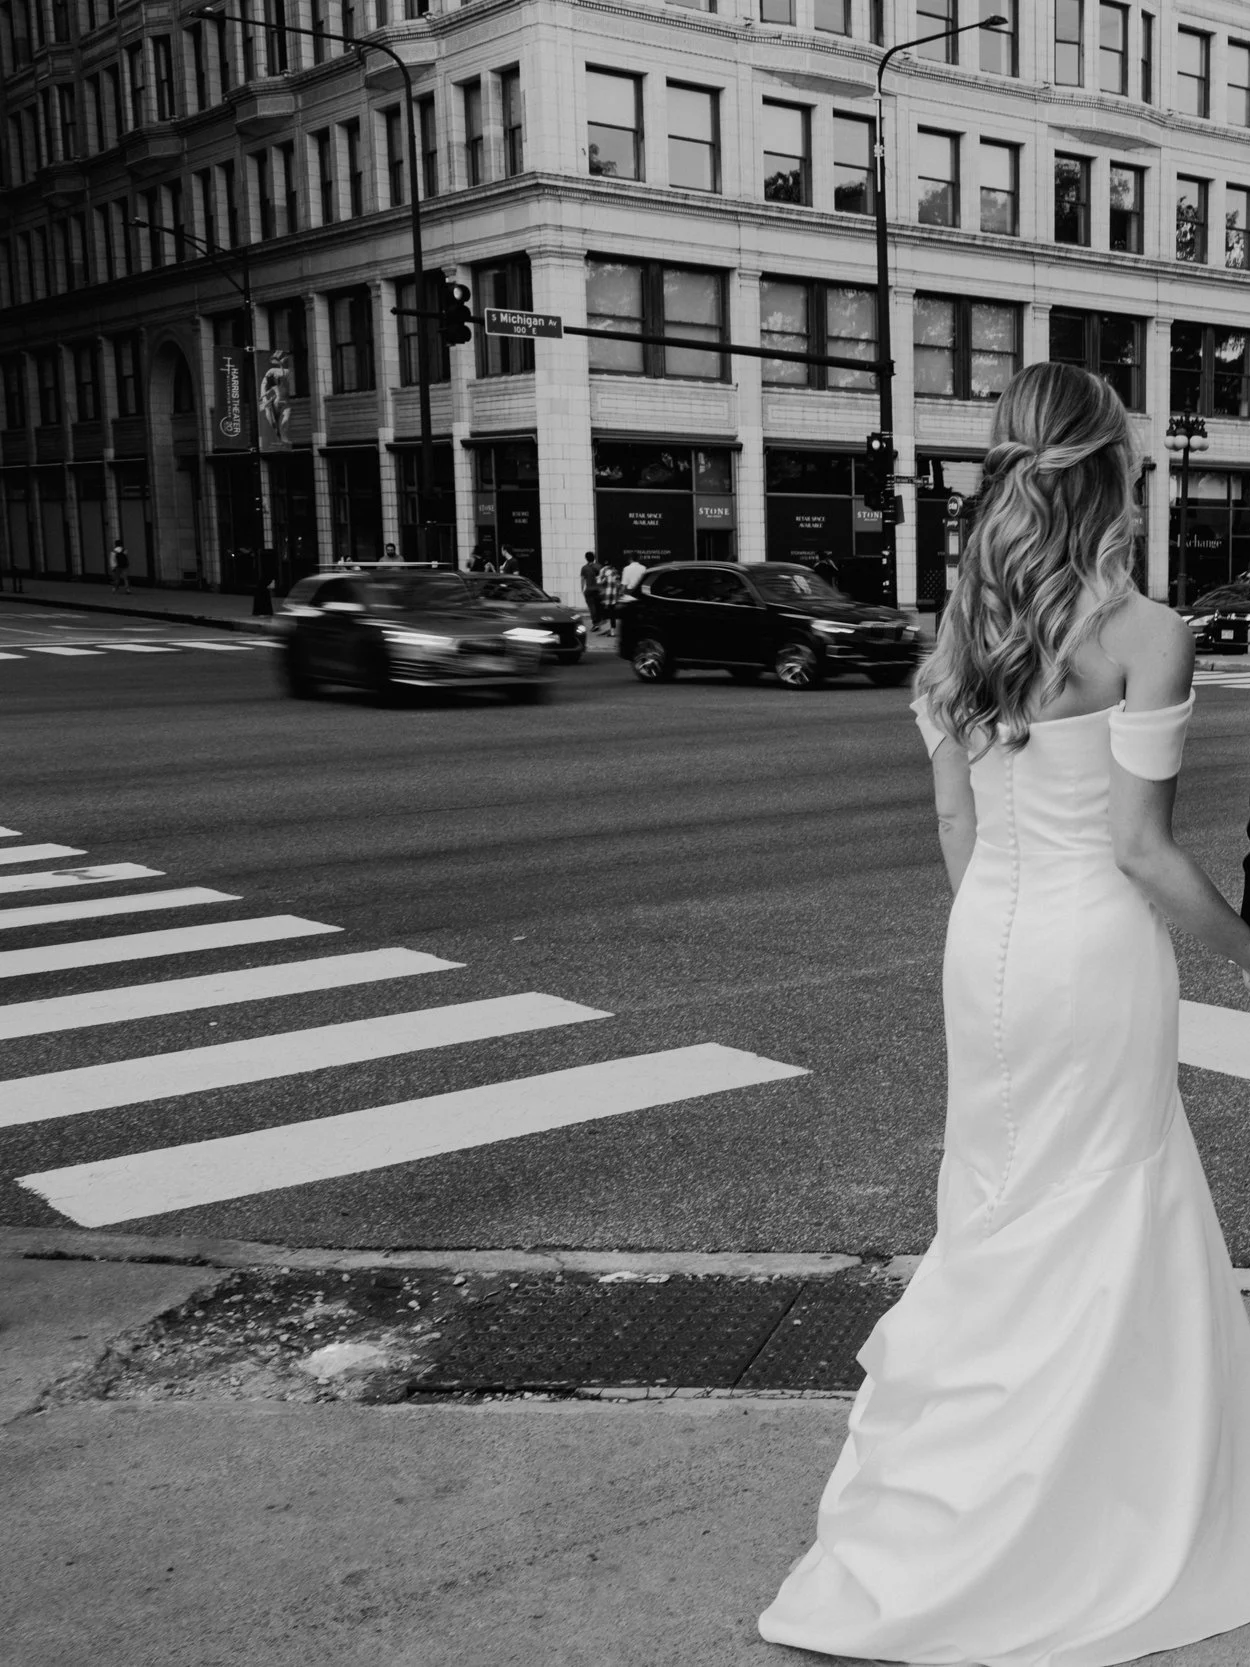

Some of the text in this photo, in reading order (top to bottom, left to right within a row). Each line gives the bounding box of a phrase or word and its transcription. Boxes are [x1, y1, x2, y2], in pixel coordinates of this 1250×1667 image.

[491, 312, 557, 328] S Michigan Av
[514, 326, 538, 335] 100 E
[231, 368, 242, 434] HARRIS THEATER
[698, 507, 730, 516] STONE
